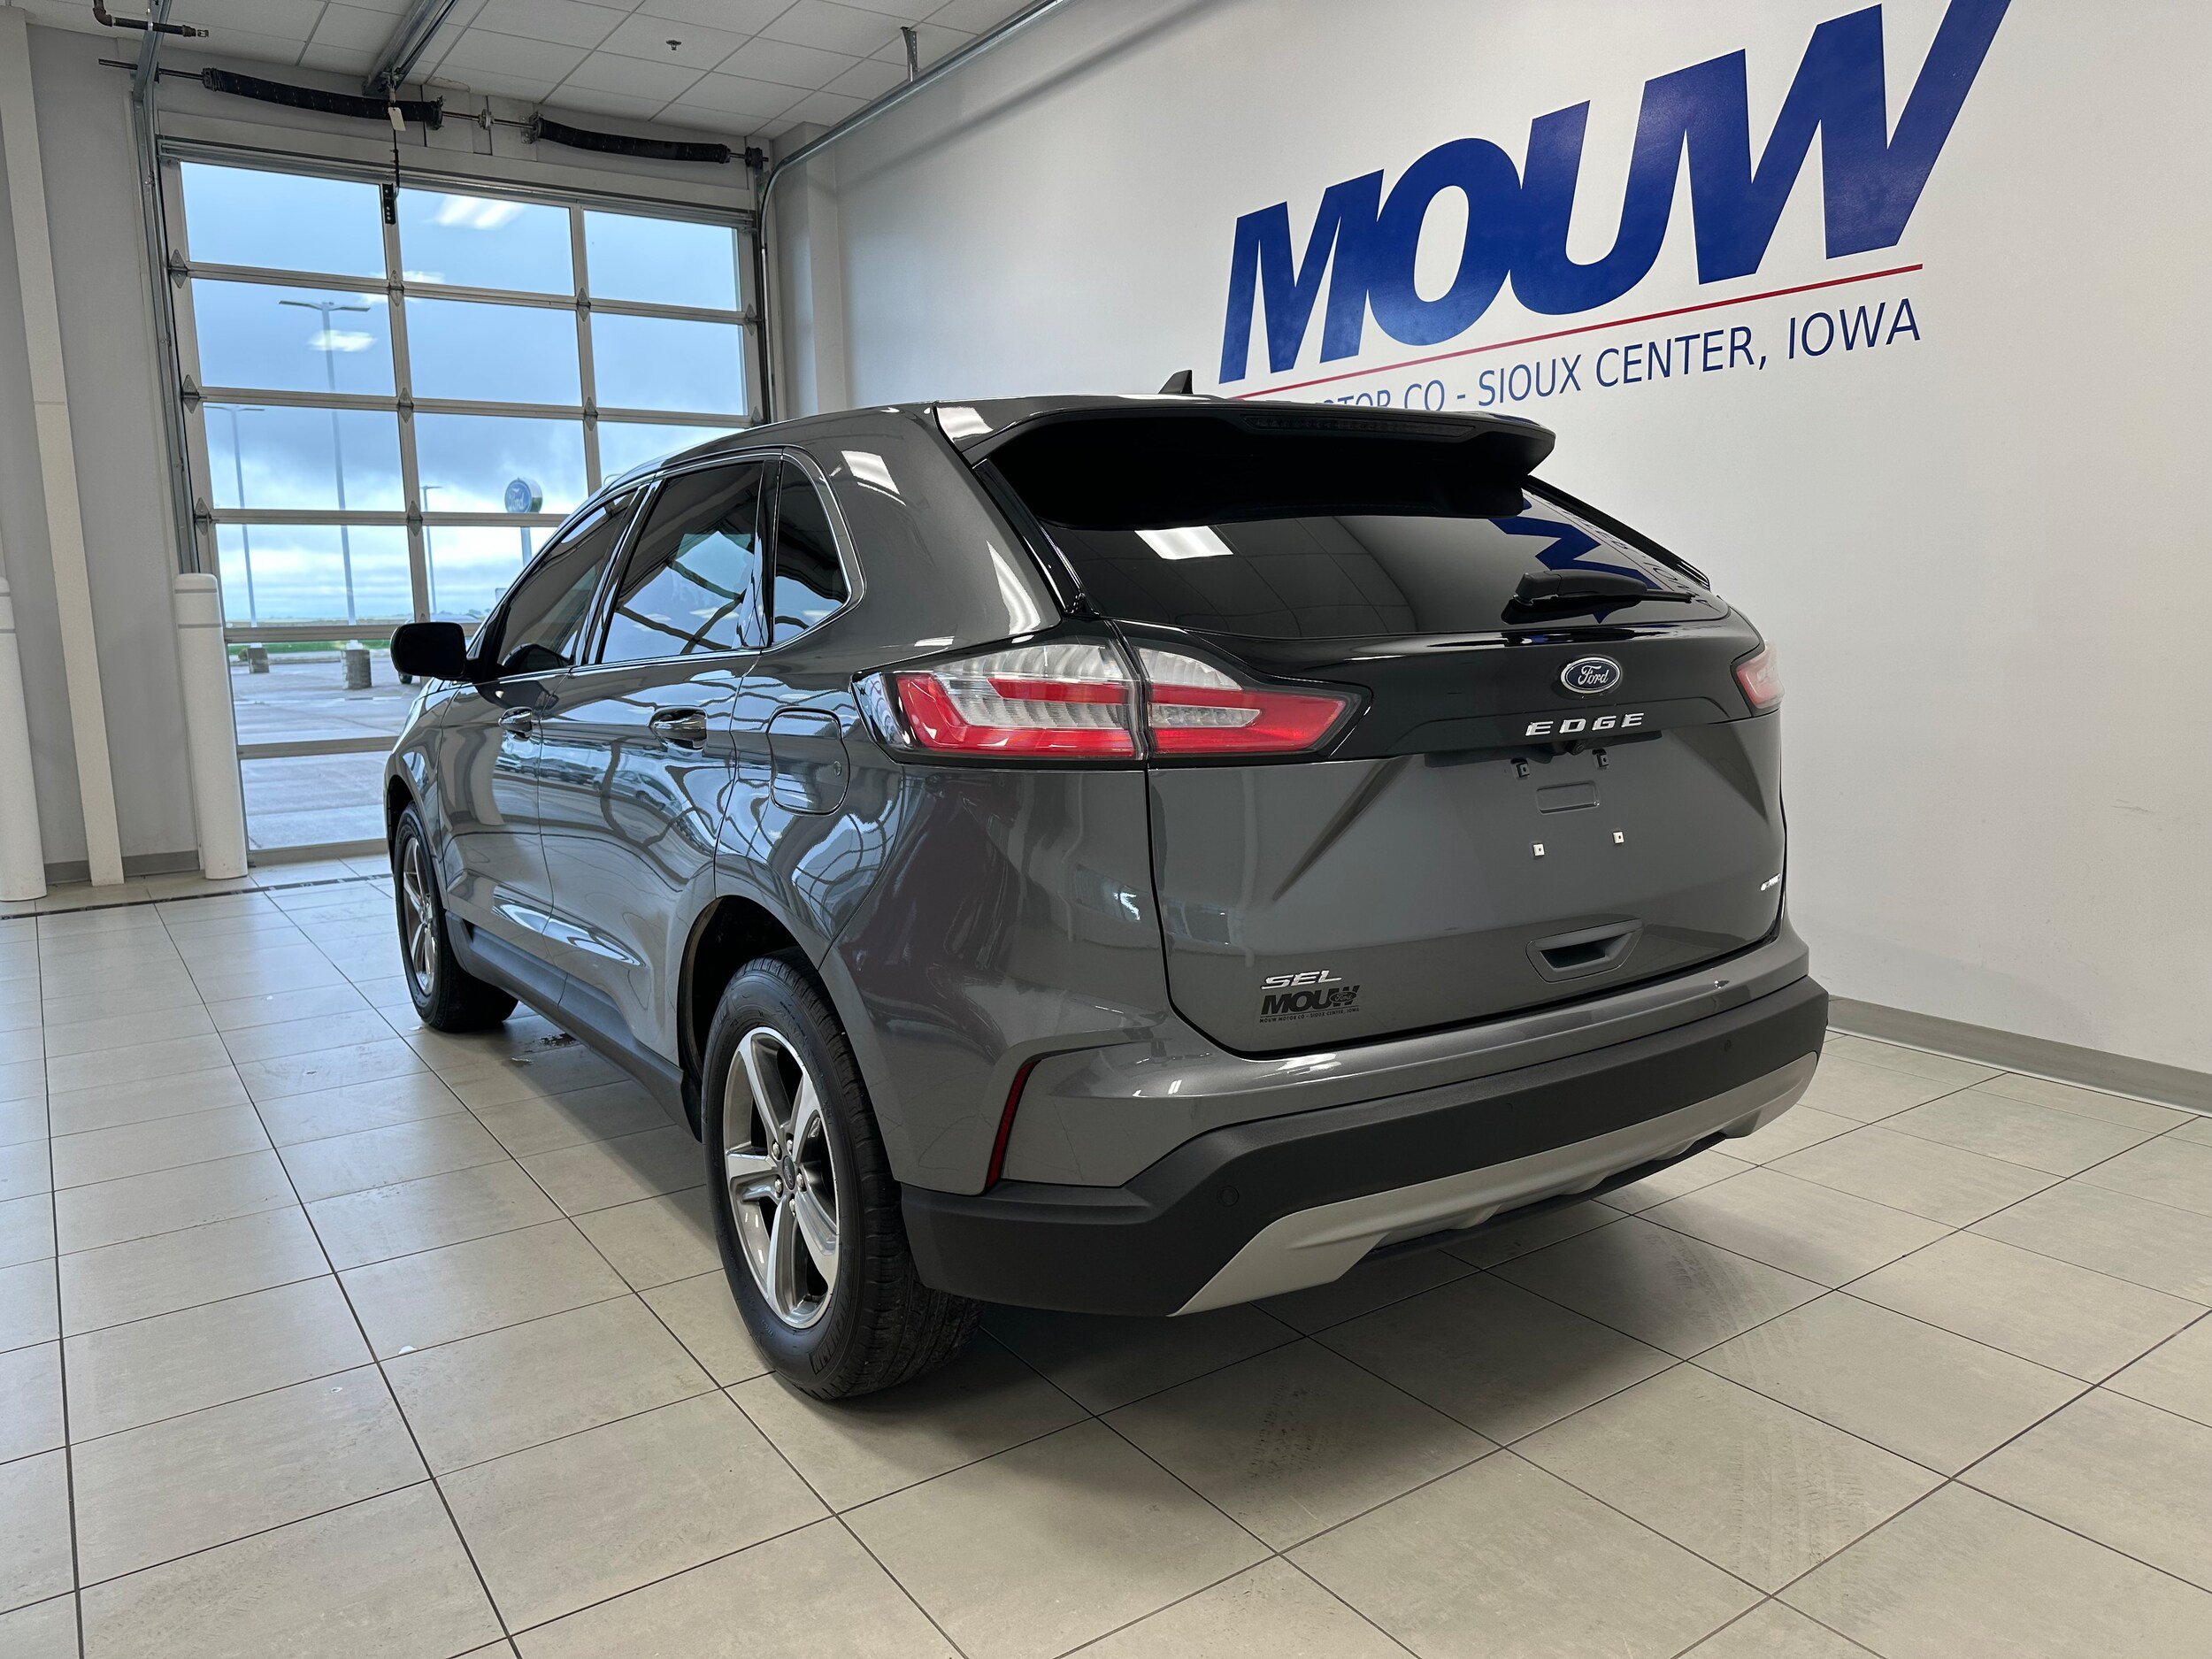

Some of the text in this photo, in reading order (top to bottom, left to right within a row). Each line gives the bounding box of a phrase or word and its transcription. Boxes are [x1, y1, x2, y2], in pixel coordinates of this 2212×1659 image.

[1219, 0, 2010, 384] MOUW
[1403, 380, 1446, 411] CO
[1478, 355, 1582, 407] SIOUX
[1595, 325, 1768, 388] CENTER,
[1788, 298, 1921, 360] IOWA
[1577, 664, 1609, 685] Ford
[1525, 712, 1645, 736] EDGE
[1261, 970, 1342, 990] SEL
